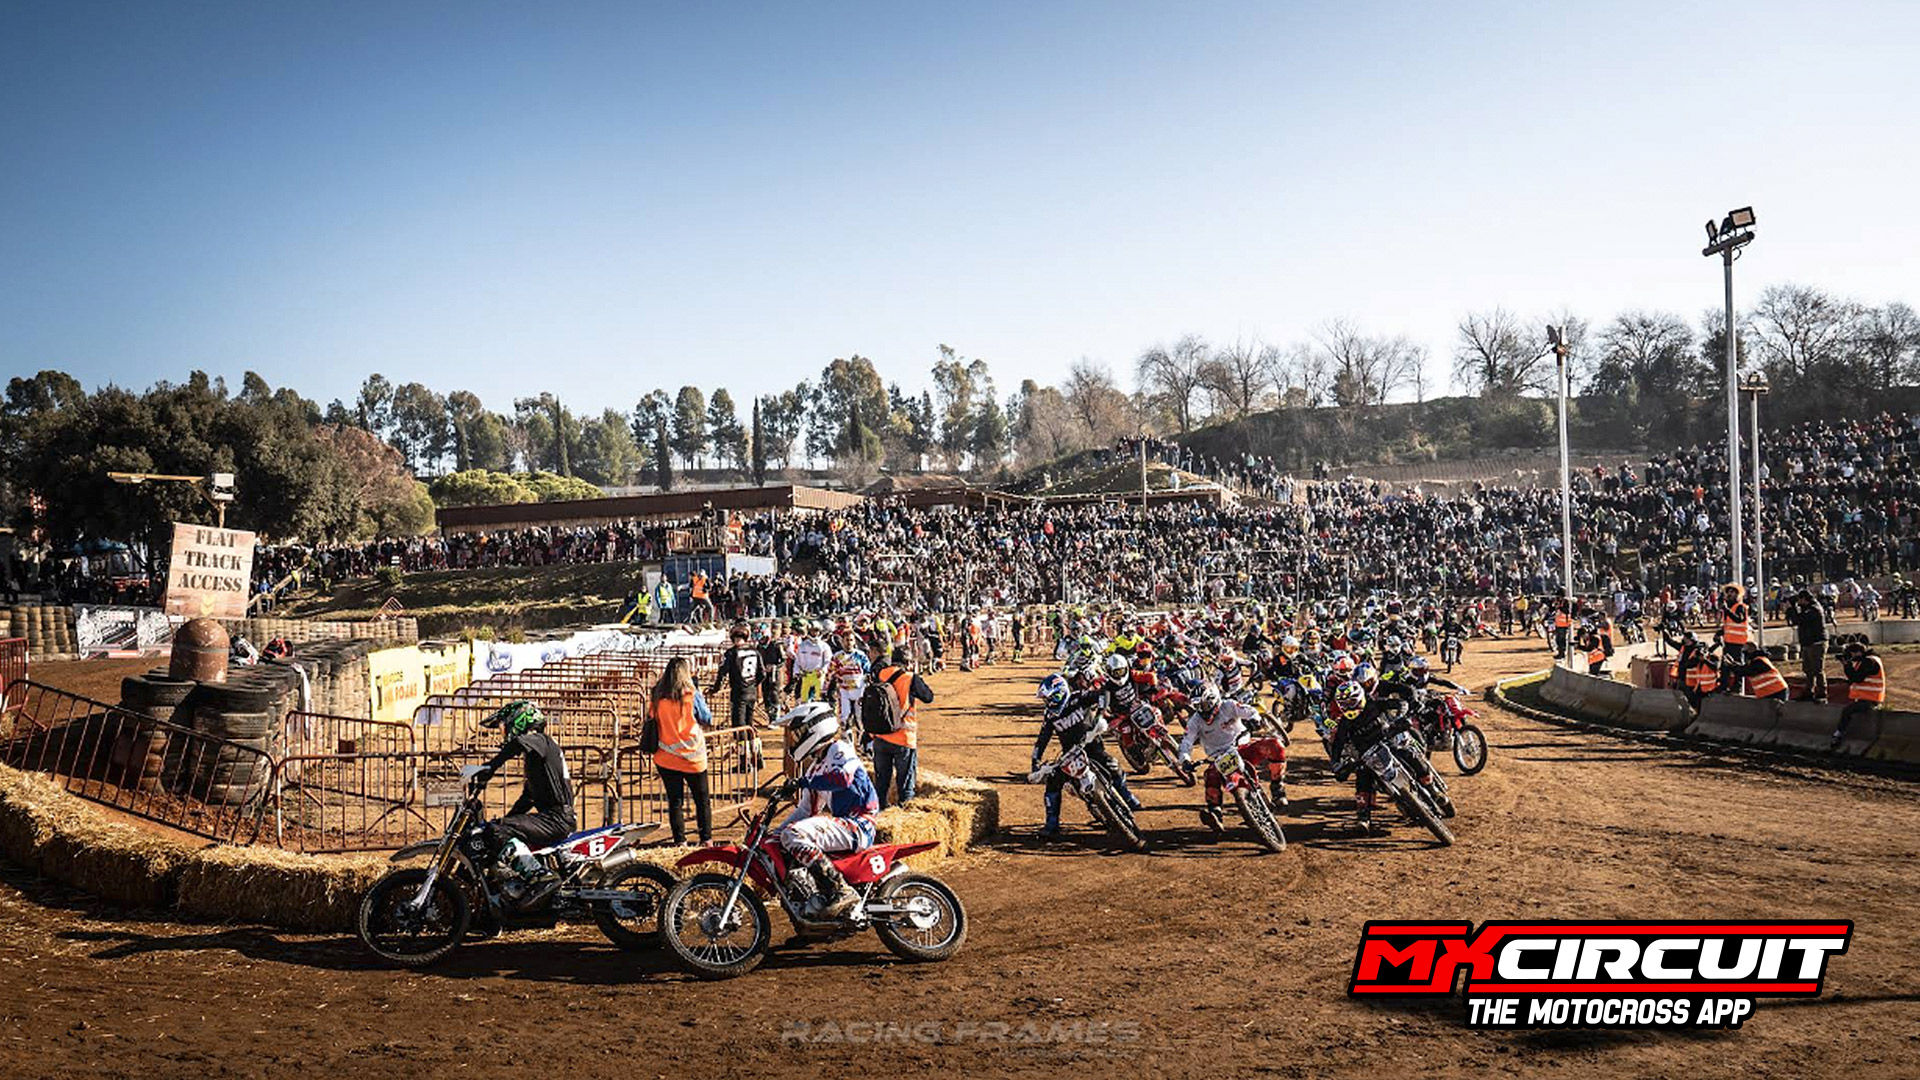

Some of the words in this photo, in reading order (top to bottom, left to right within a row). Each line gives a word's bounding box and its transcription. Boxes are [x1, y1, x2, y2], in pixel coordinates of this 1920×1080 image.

[195, 529, 238, 548] FLAT
[184, 550, 242, 571] TRACK
[177, 573, 242, 592] ACCESS
[589, 837, 606, 857] 6
[869, 854, 886, 875] 8
